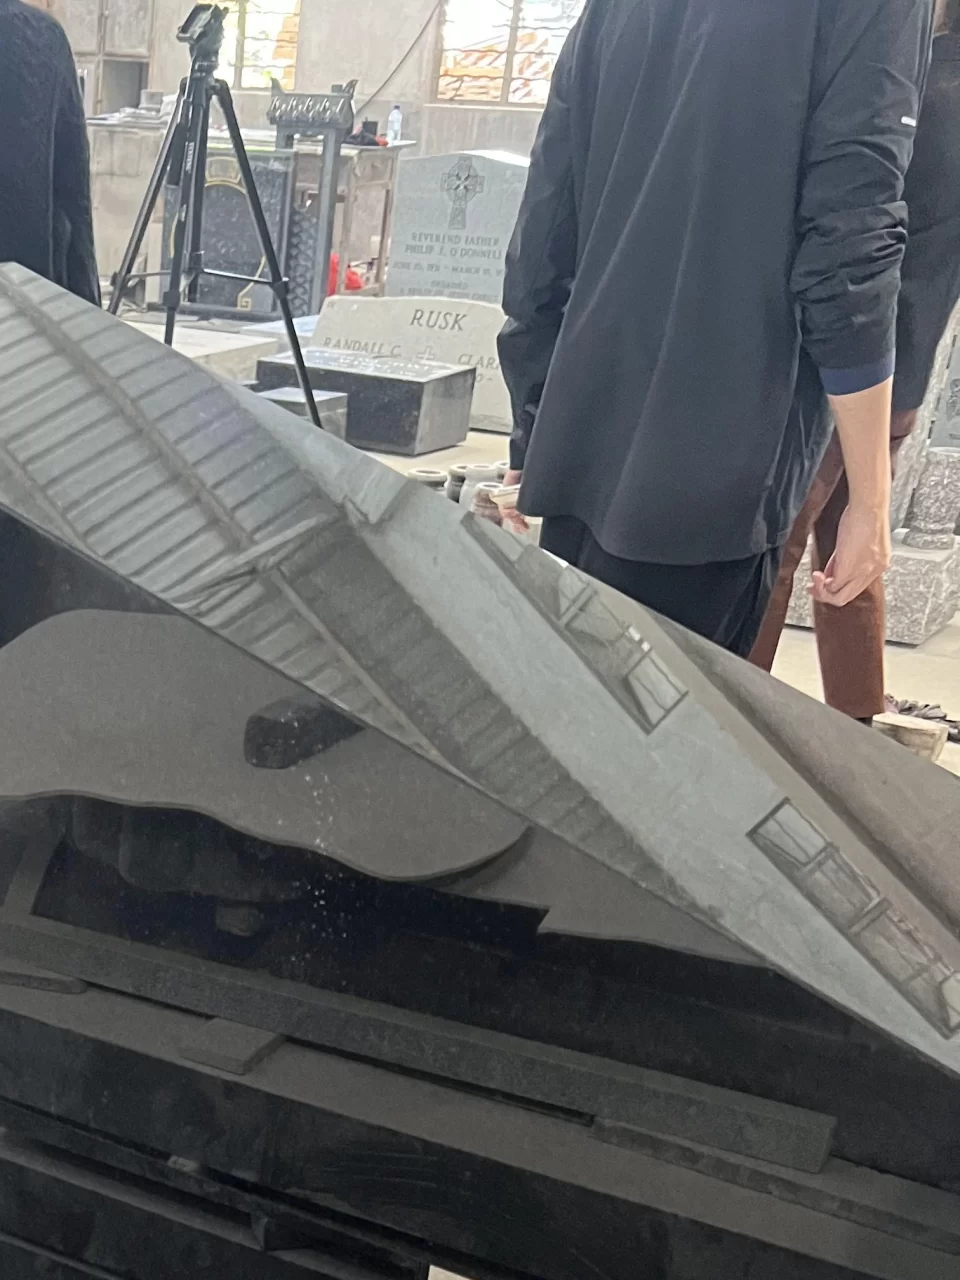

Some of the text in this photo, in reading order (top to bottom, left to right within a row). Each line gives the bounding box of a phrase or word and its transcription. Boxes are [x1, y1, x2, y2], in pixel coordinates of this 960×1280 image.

[411, 232, 500, 246] REVEREND FATHER
[404, 244, 434, 255] PHILIP
[409, 308, 468, 332] RUSK
[323, 337, 384, 354] RANDALL
